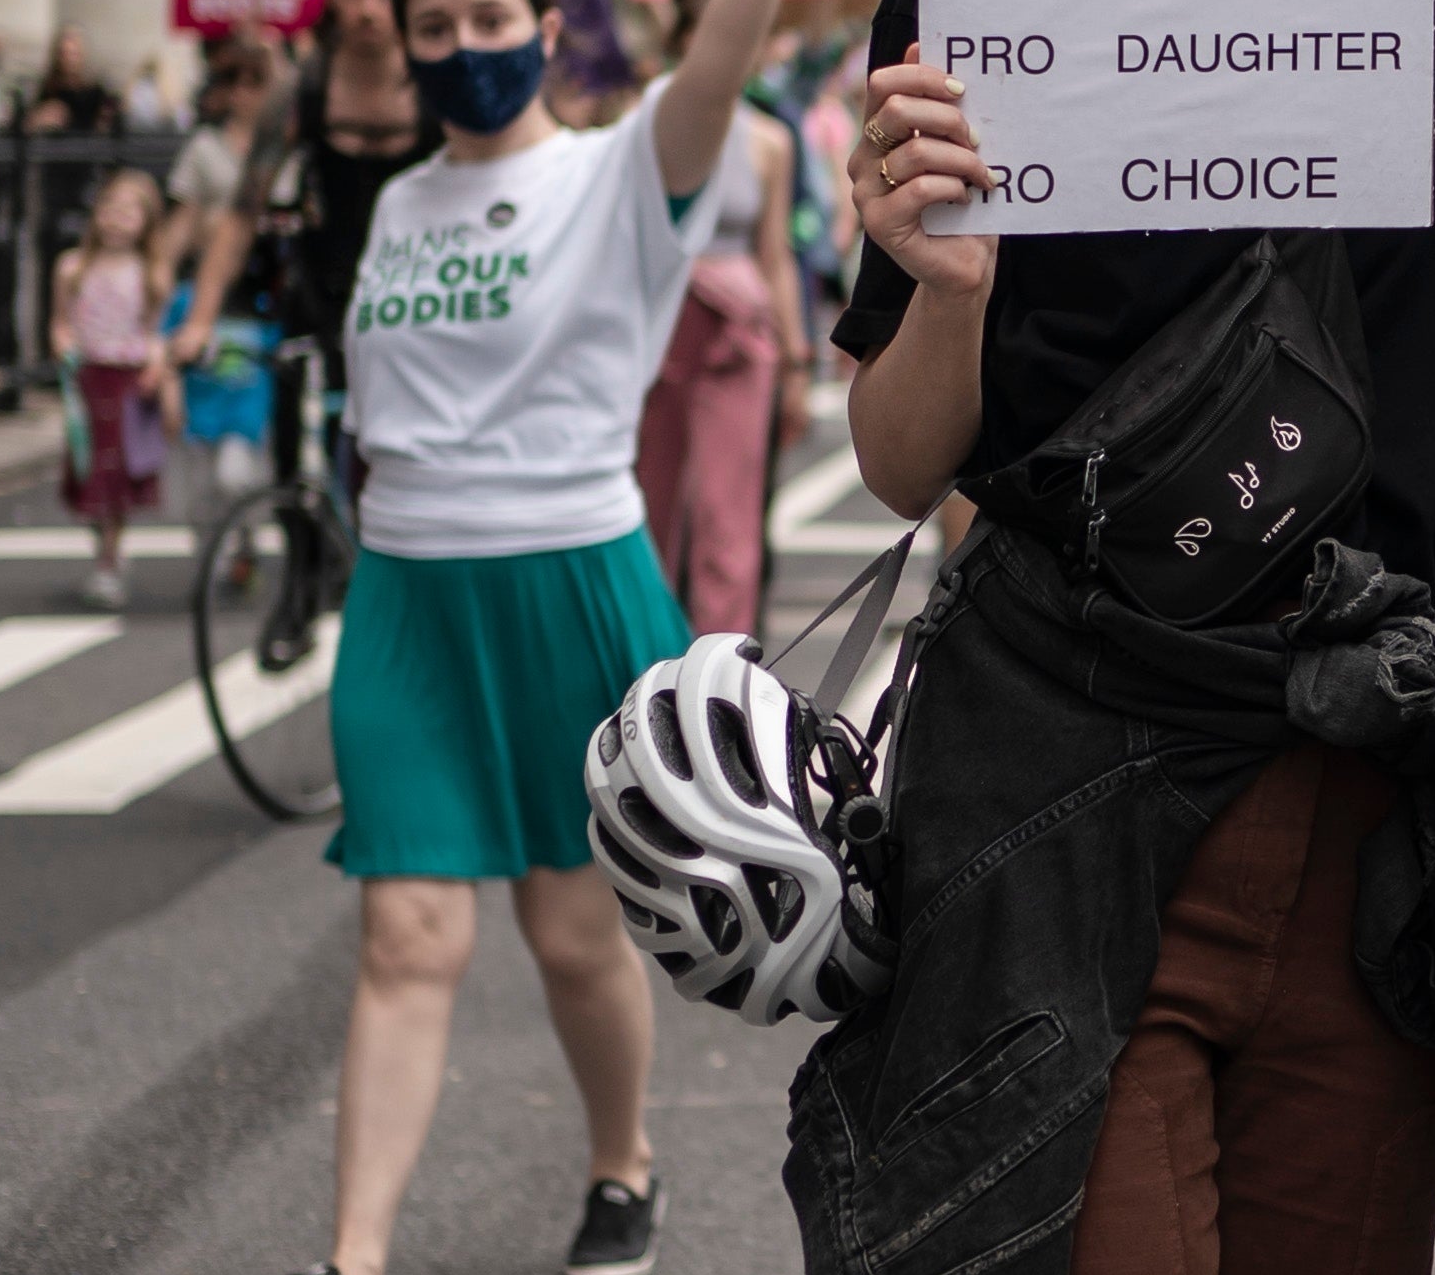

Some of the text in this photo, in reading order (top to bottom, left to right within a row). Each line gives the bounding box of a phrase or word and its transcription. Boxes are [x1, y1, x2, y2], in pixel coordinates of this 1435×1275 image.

[945, 31, 1402, 76] PRO DAUGHTER
[947, 155, 1339, 204] RO CHOICE
[437, 250, 529, 288] OUR
[356, 283, 512, 334] BODIES
[1271, 507, 1296, 534] STUDIO
